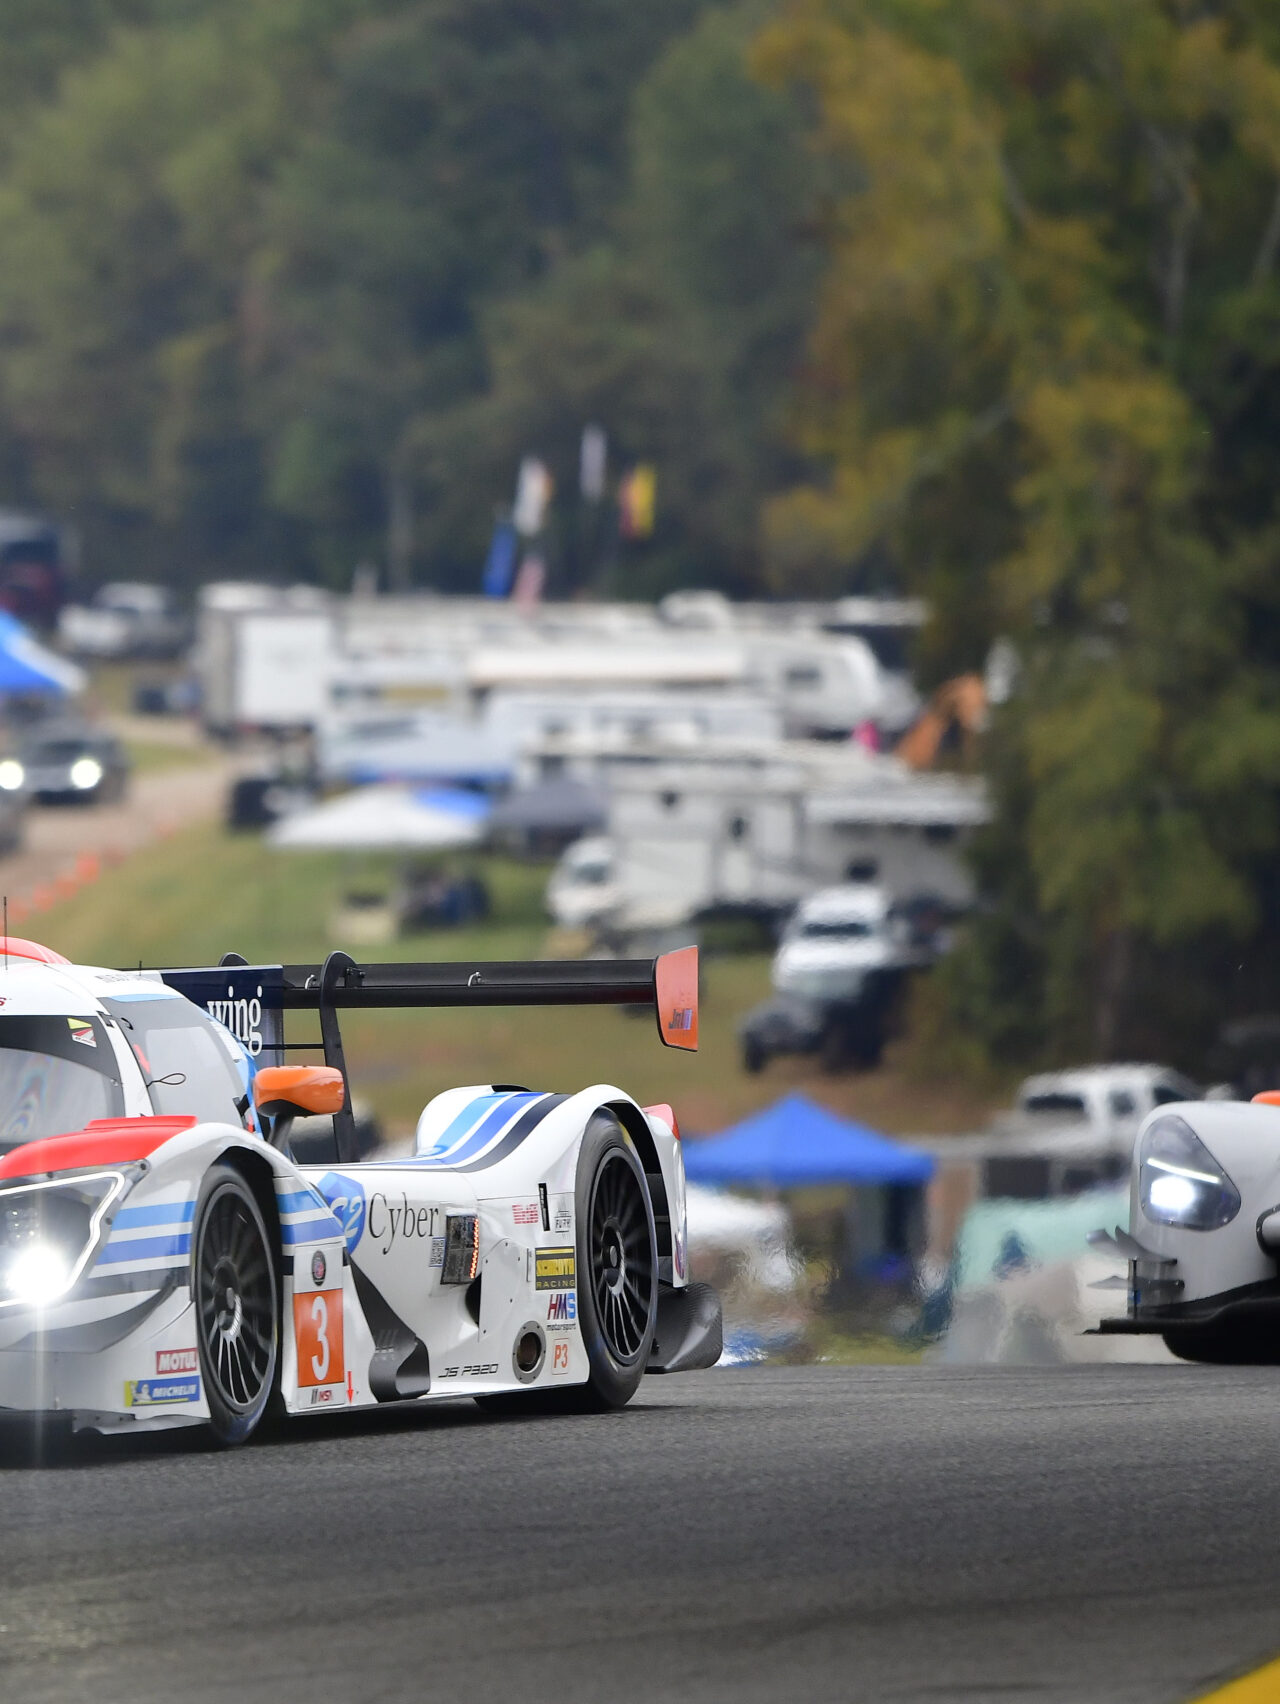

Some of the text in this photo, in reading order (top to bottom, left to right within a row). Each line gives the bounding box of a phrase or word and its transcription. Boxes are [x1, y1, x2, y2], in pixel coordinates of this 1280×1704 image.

[368, 1192, 439, 1255] Cyber
[536, 1279, 576, 1288] RACING
[547, 1292, 576, 1320] HMS
[311, 1295, 330, 1381] 3
[158, 1351, 196, 1371] MOTUL
[554, 1344, 568, 1369] P3
[438, 1366, 459, 1378] JS
